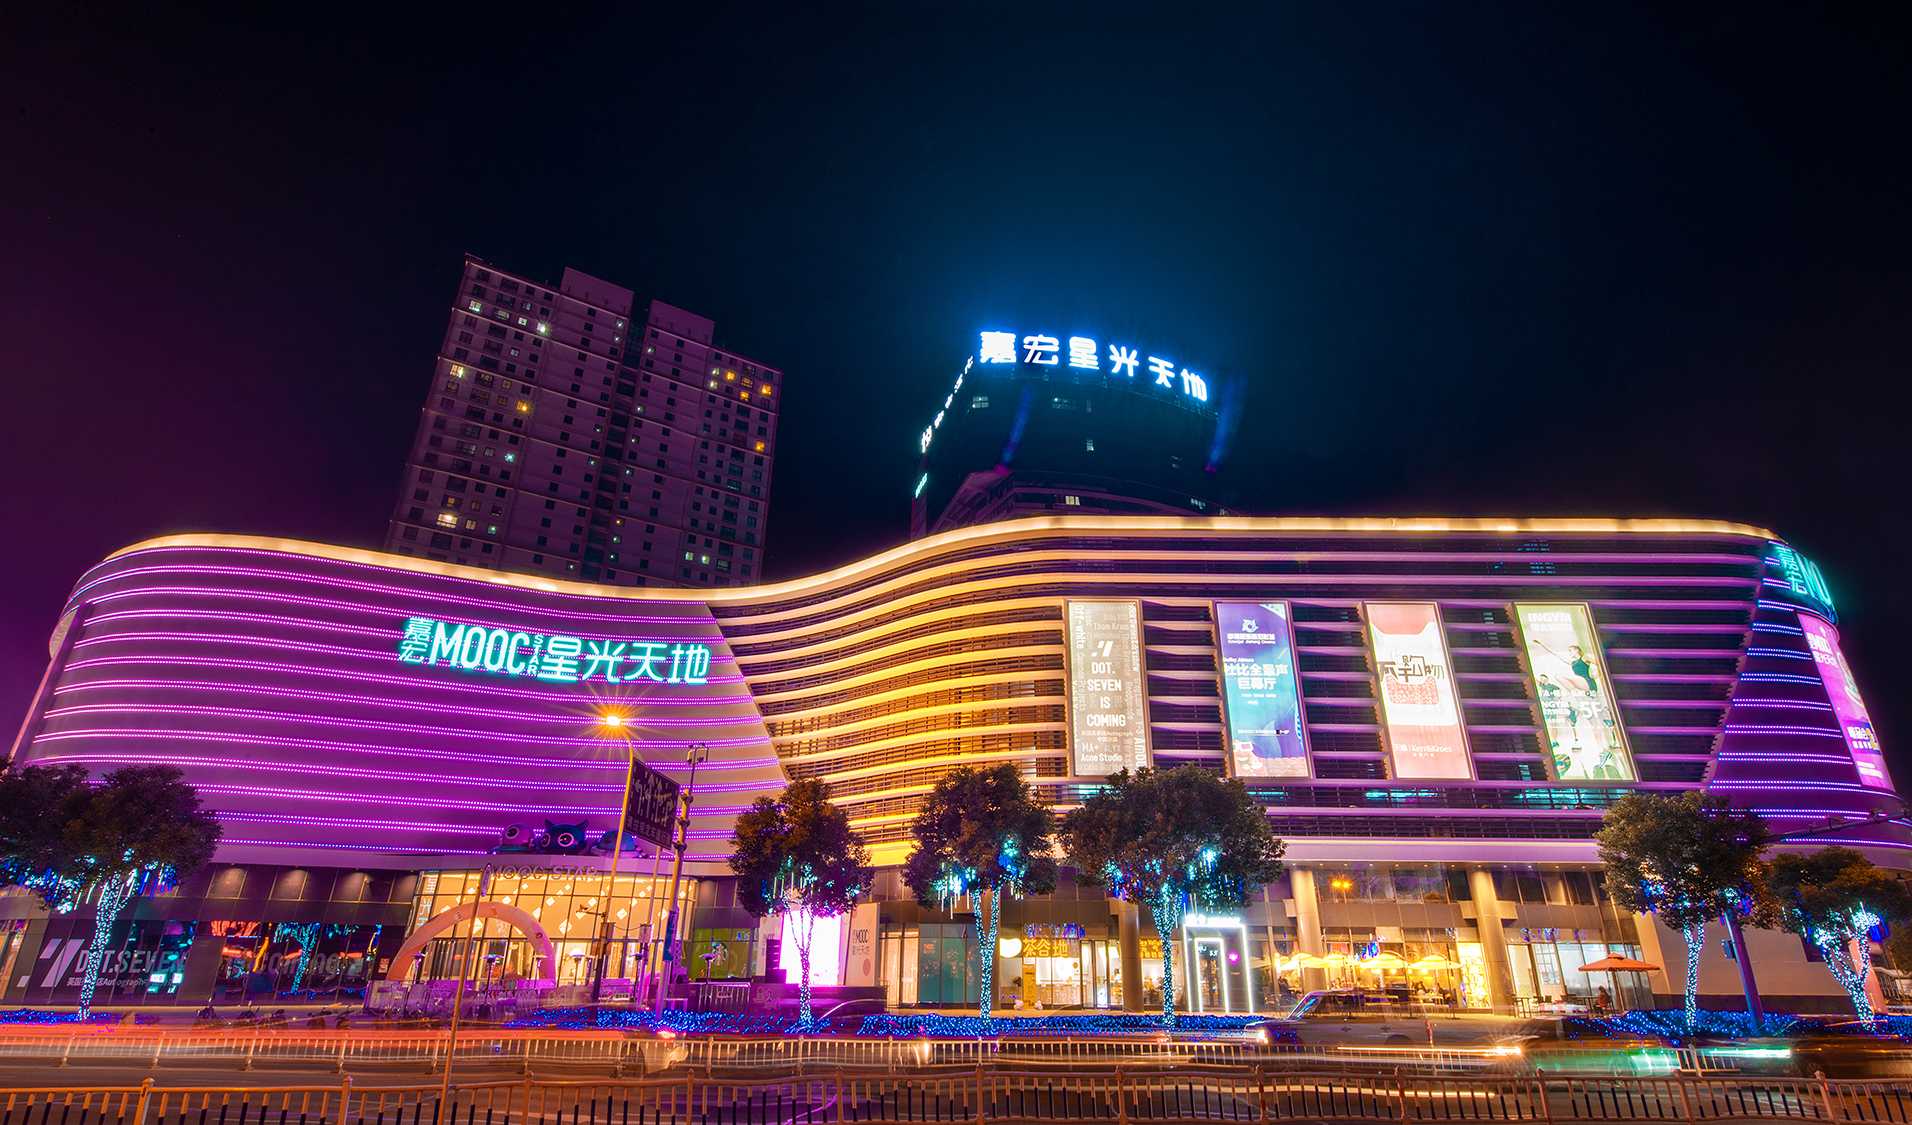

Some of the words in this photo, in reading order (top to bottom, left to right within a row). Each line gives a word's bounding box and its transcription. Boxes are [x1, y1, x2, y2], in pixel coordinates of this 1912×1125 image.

[980, 331, 1208, 401] 嘉宏星光天地
[1527, 613, 1572, 623] INGYM
[1074, 605, 1086, 649] Off-white
[399, 617, 434, 662] 嘉宏
[429, 621, 530, 674] MOOC
[527, 634, 544, 675] STAR
[537, 635, 711, 684] 星光天地
[1091, 662, 1116, 674] DOT.
[1086, 679, 1122, 691] SEVEN
[1100, 696, 1111, 709] IS
[1580, 701, 1603, 719] 5F
[1086, 714, 1126, 727] COMING
[1082, 742, 1100, 752] MA+
[1080, 753, 1098, 762] Acne
[1099, 753, 1123, 762] Studio
[551, 865, 598, 882] STAR
[1022, 937, 1068, 957] 茶谷地
